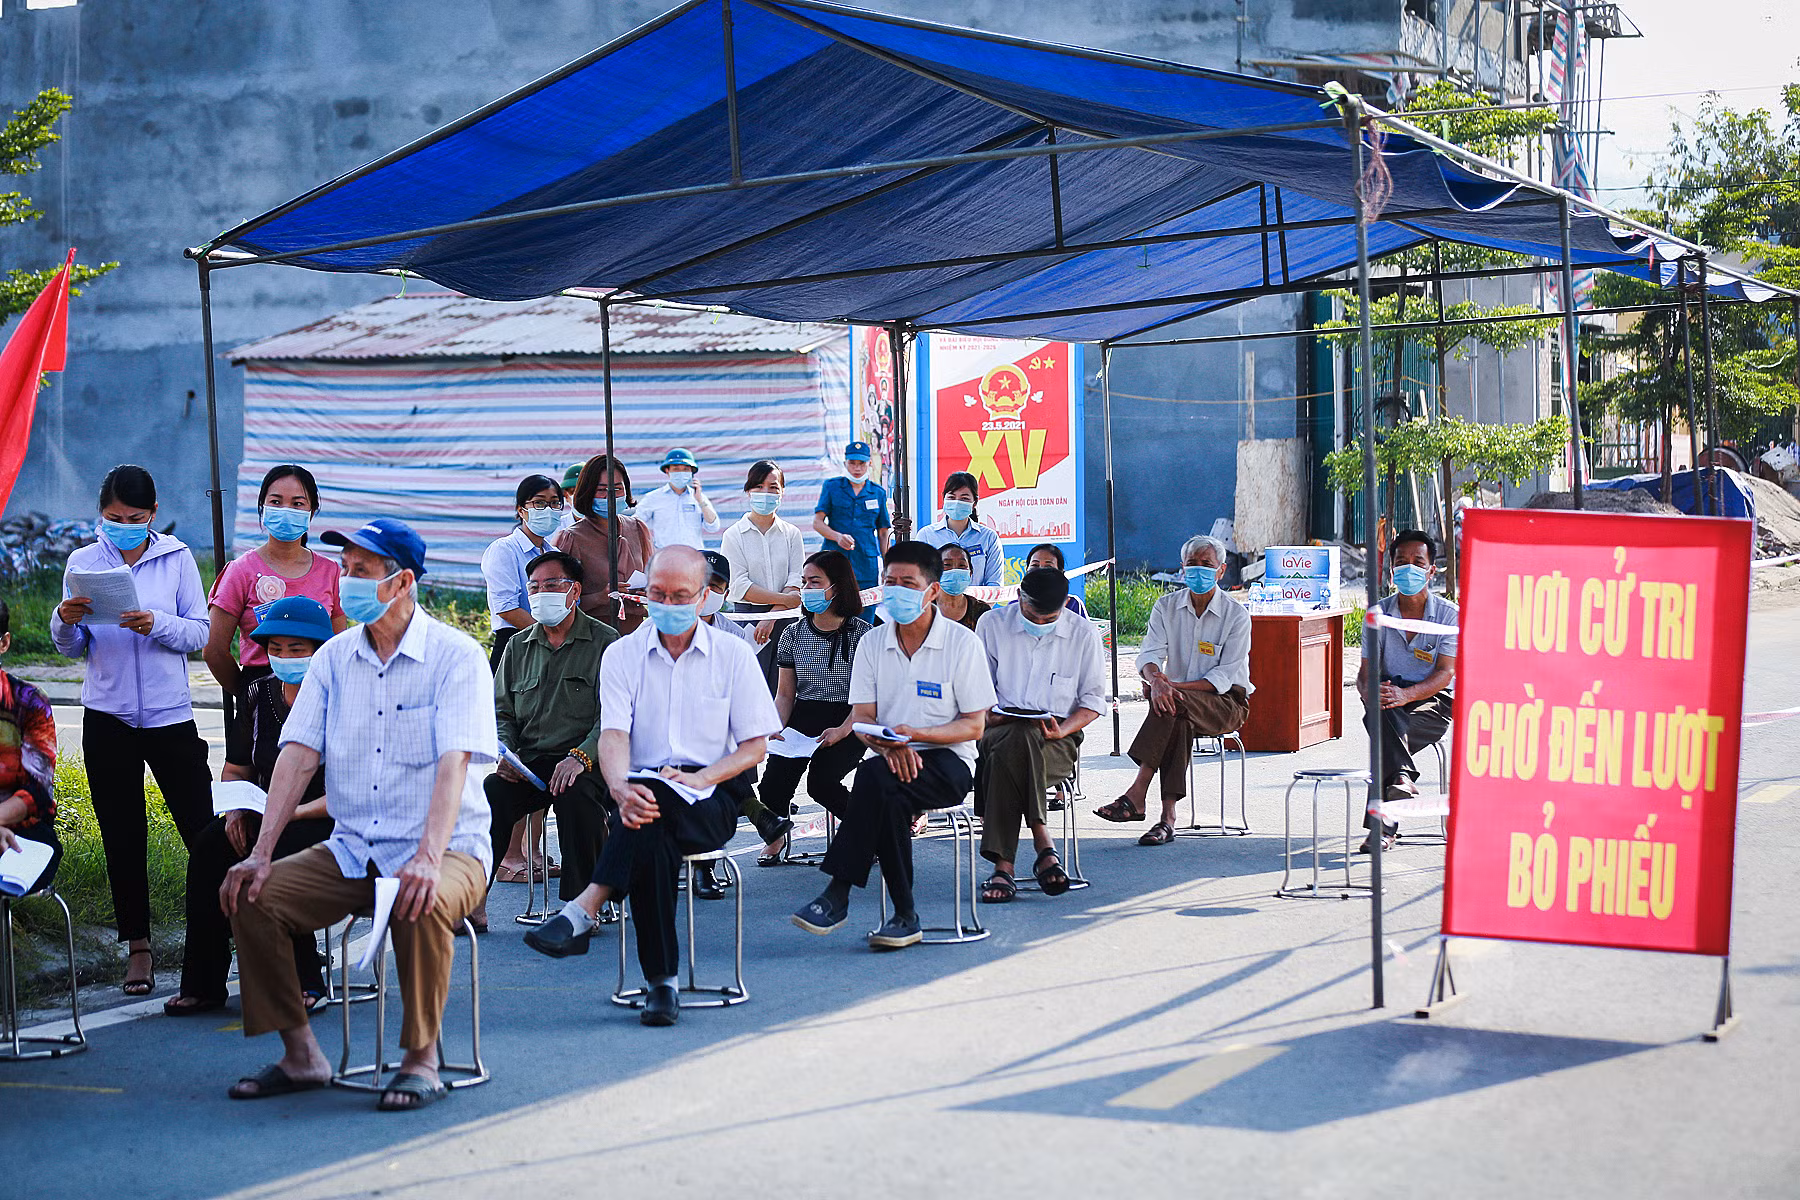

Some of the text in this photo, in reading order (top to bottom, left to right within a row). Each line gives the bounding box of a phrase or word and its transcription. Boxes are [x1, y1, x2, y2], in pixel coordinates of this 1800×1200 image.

[959, 429, 1048, 489] XV
[981, 421, 1026, 430] 23.5.2021
[998, 495, 1068, 508] NGÀY HỘI CỦA TOÀN DÂN
[1504, 545, 1698, 661] NƠI CỬ TRI
[1465, 679, 1725, 809] CHỜ ĐẾN LƯỢT
[1506, 800, 1678, 921] BỎ PHIẾU
